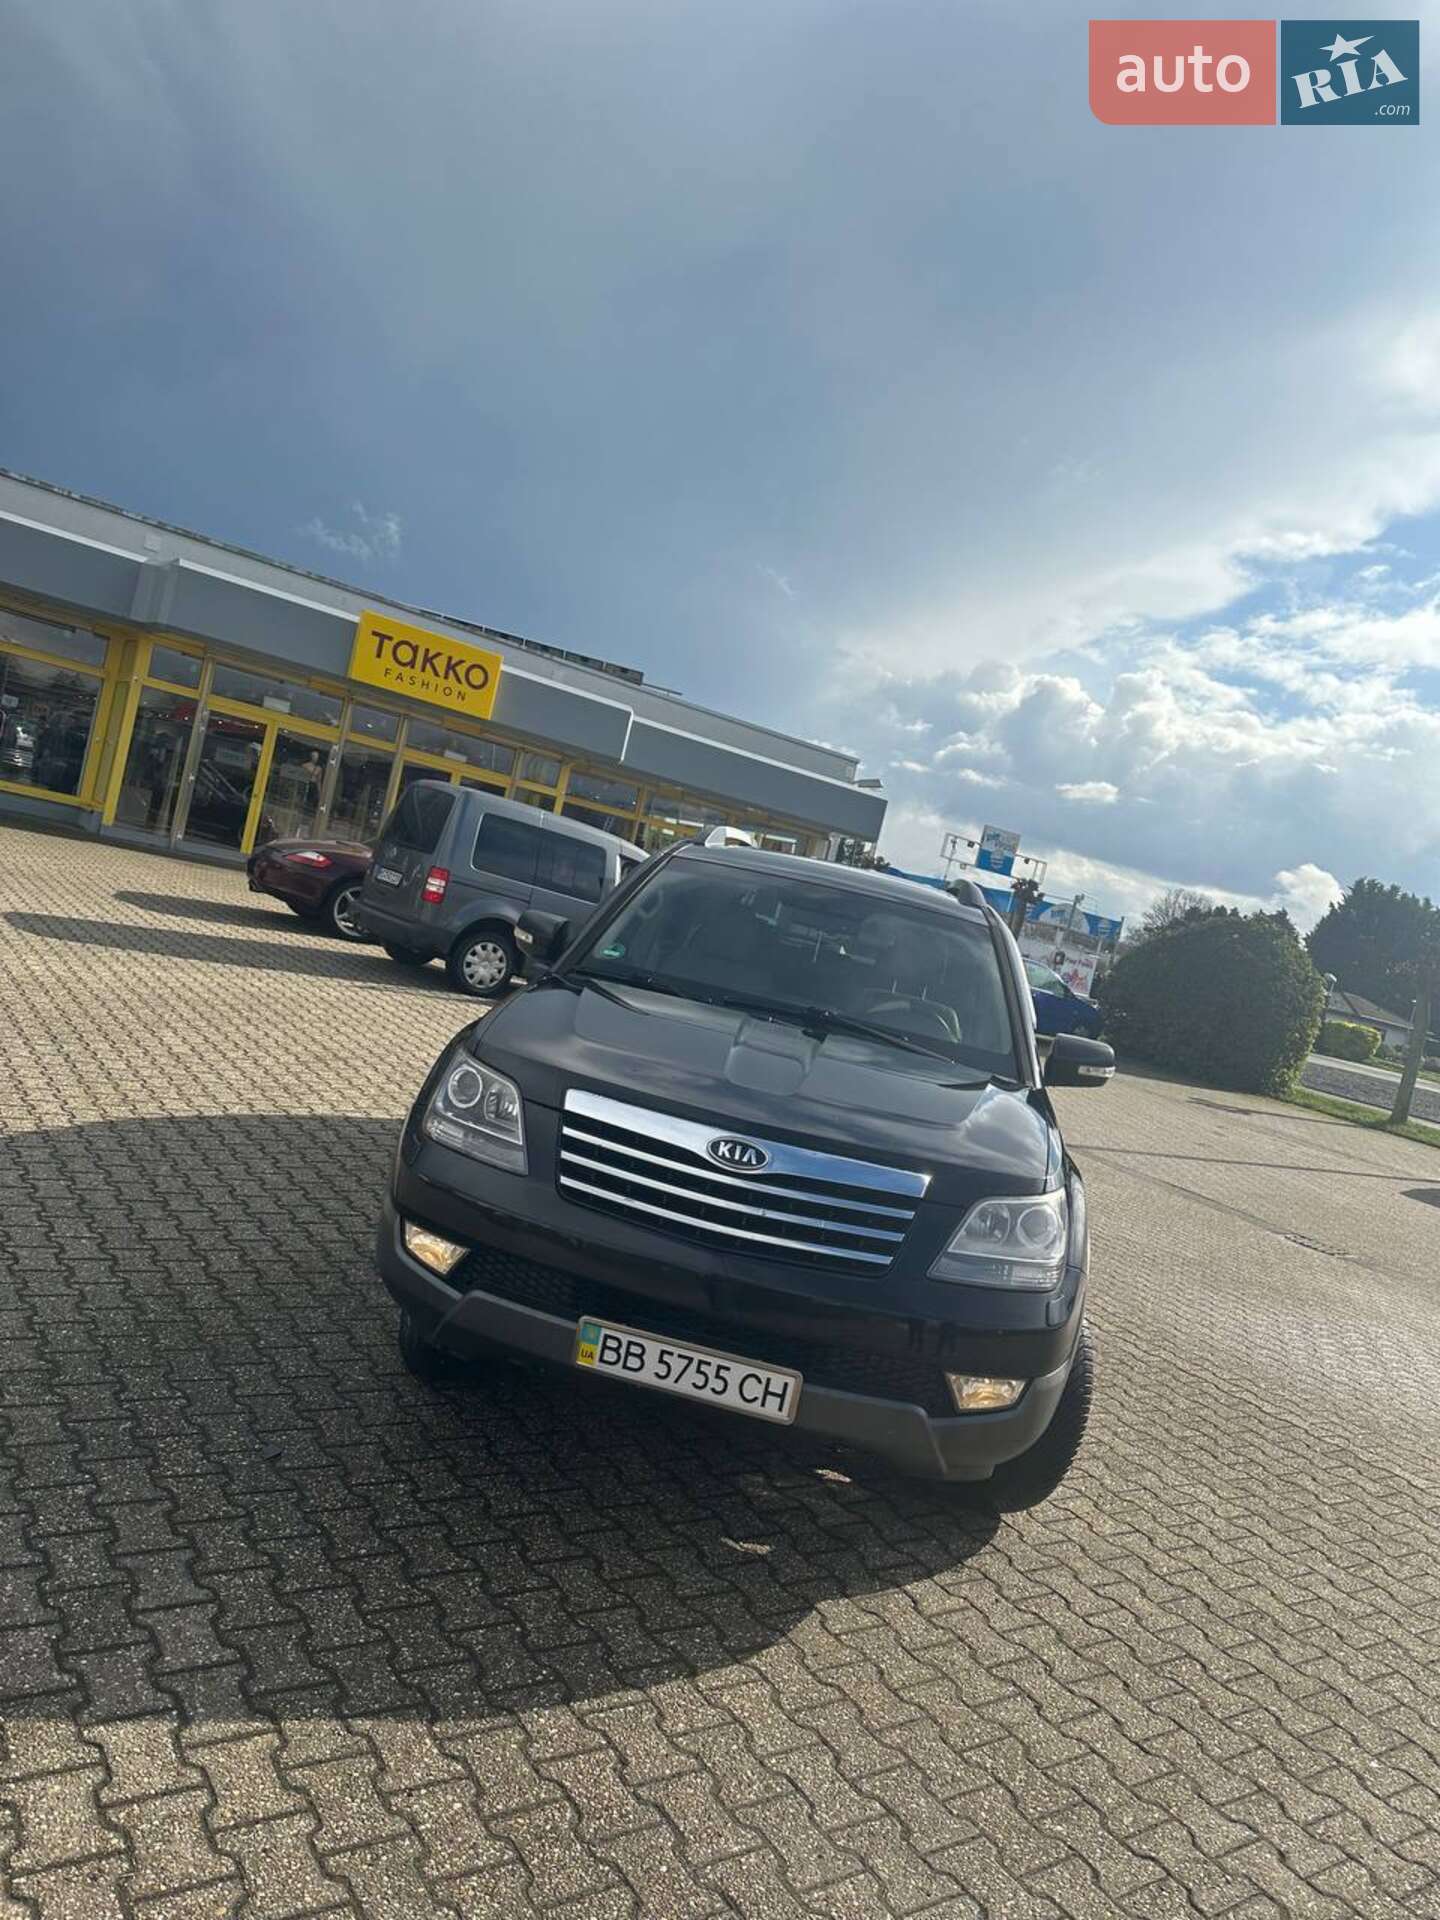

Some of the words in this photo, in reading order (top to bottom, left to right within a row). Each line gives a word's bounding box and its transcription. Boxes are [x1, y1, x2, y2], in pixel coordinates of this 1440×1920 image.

[384, 668, 466, 701] FASHION
[718, 1141, 757, 1165] KIA
[580, 1348, 594, 1360] UA
[598, 1333, 646, 1373] BB
[654, 1350, 732, 1396] 5755
[738, 1373, 789, 1412] CH
